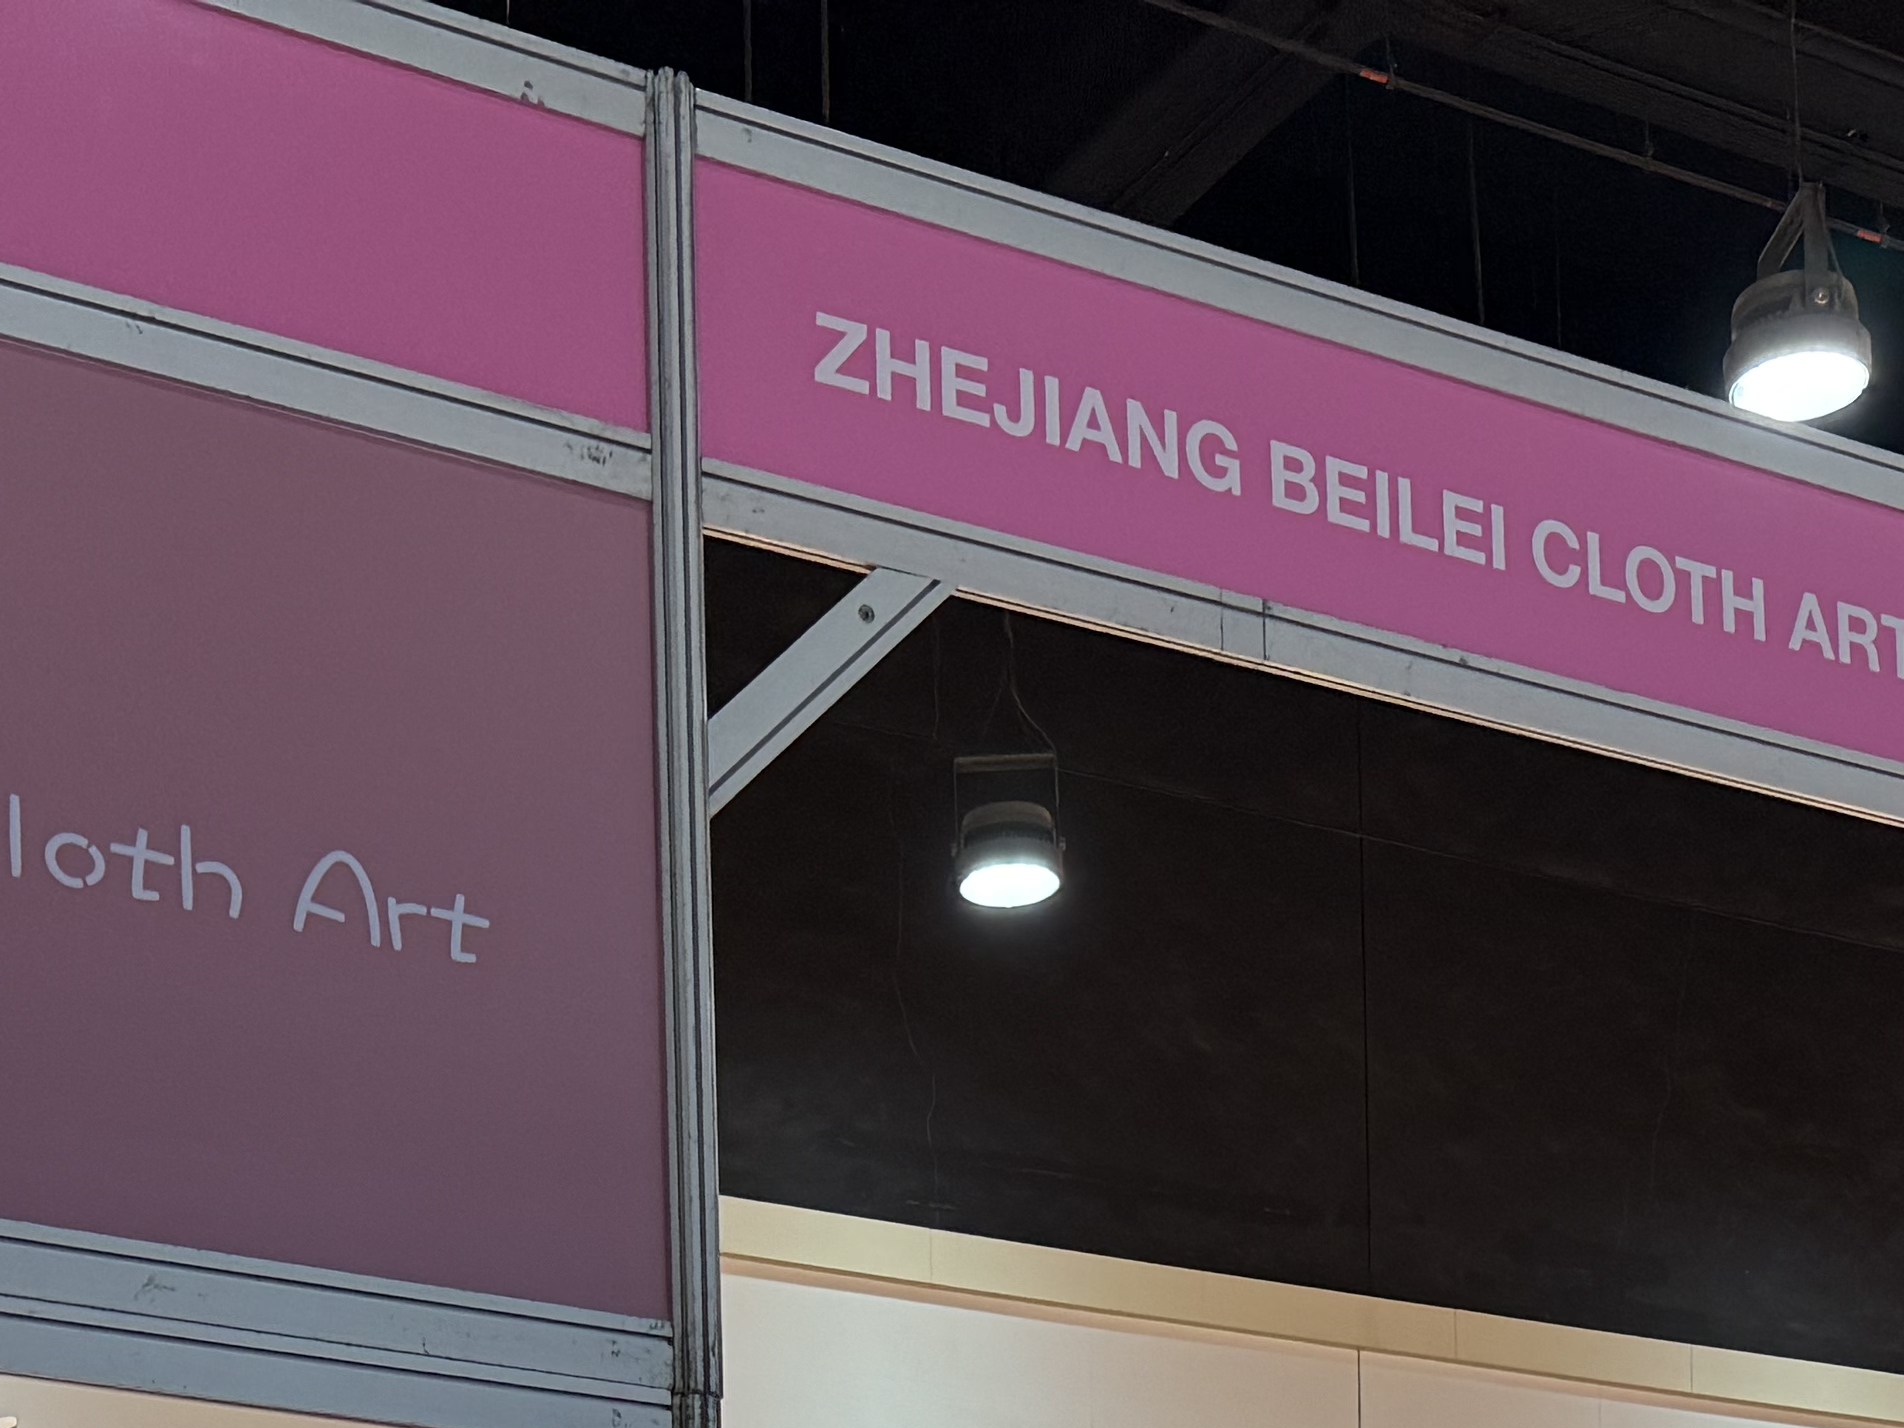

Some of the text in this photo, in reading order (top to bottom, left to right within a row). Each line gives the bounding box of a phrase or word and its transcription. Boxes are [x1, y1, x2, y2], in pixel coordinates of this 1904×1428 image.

[813, 311, 1242, 496] ZHEJIANG
[1269, 438, 1507, 572] BEILEI
[1531, 519, 1767, 644] CLOTH
[293, 851, 491, 963] Art
